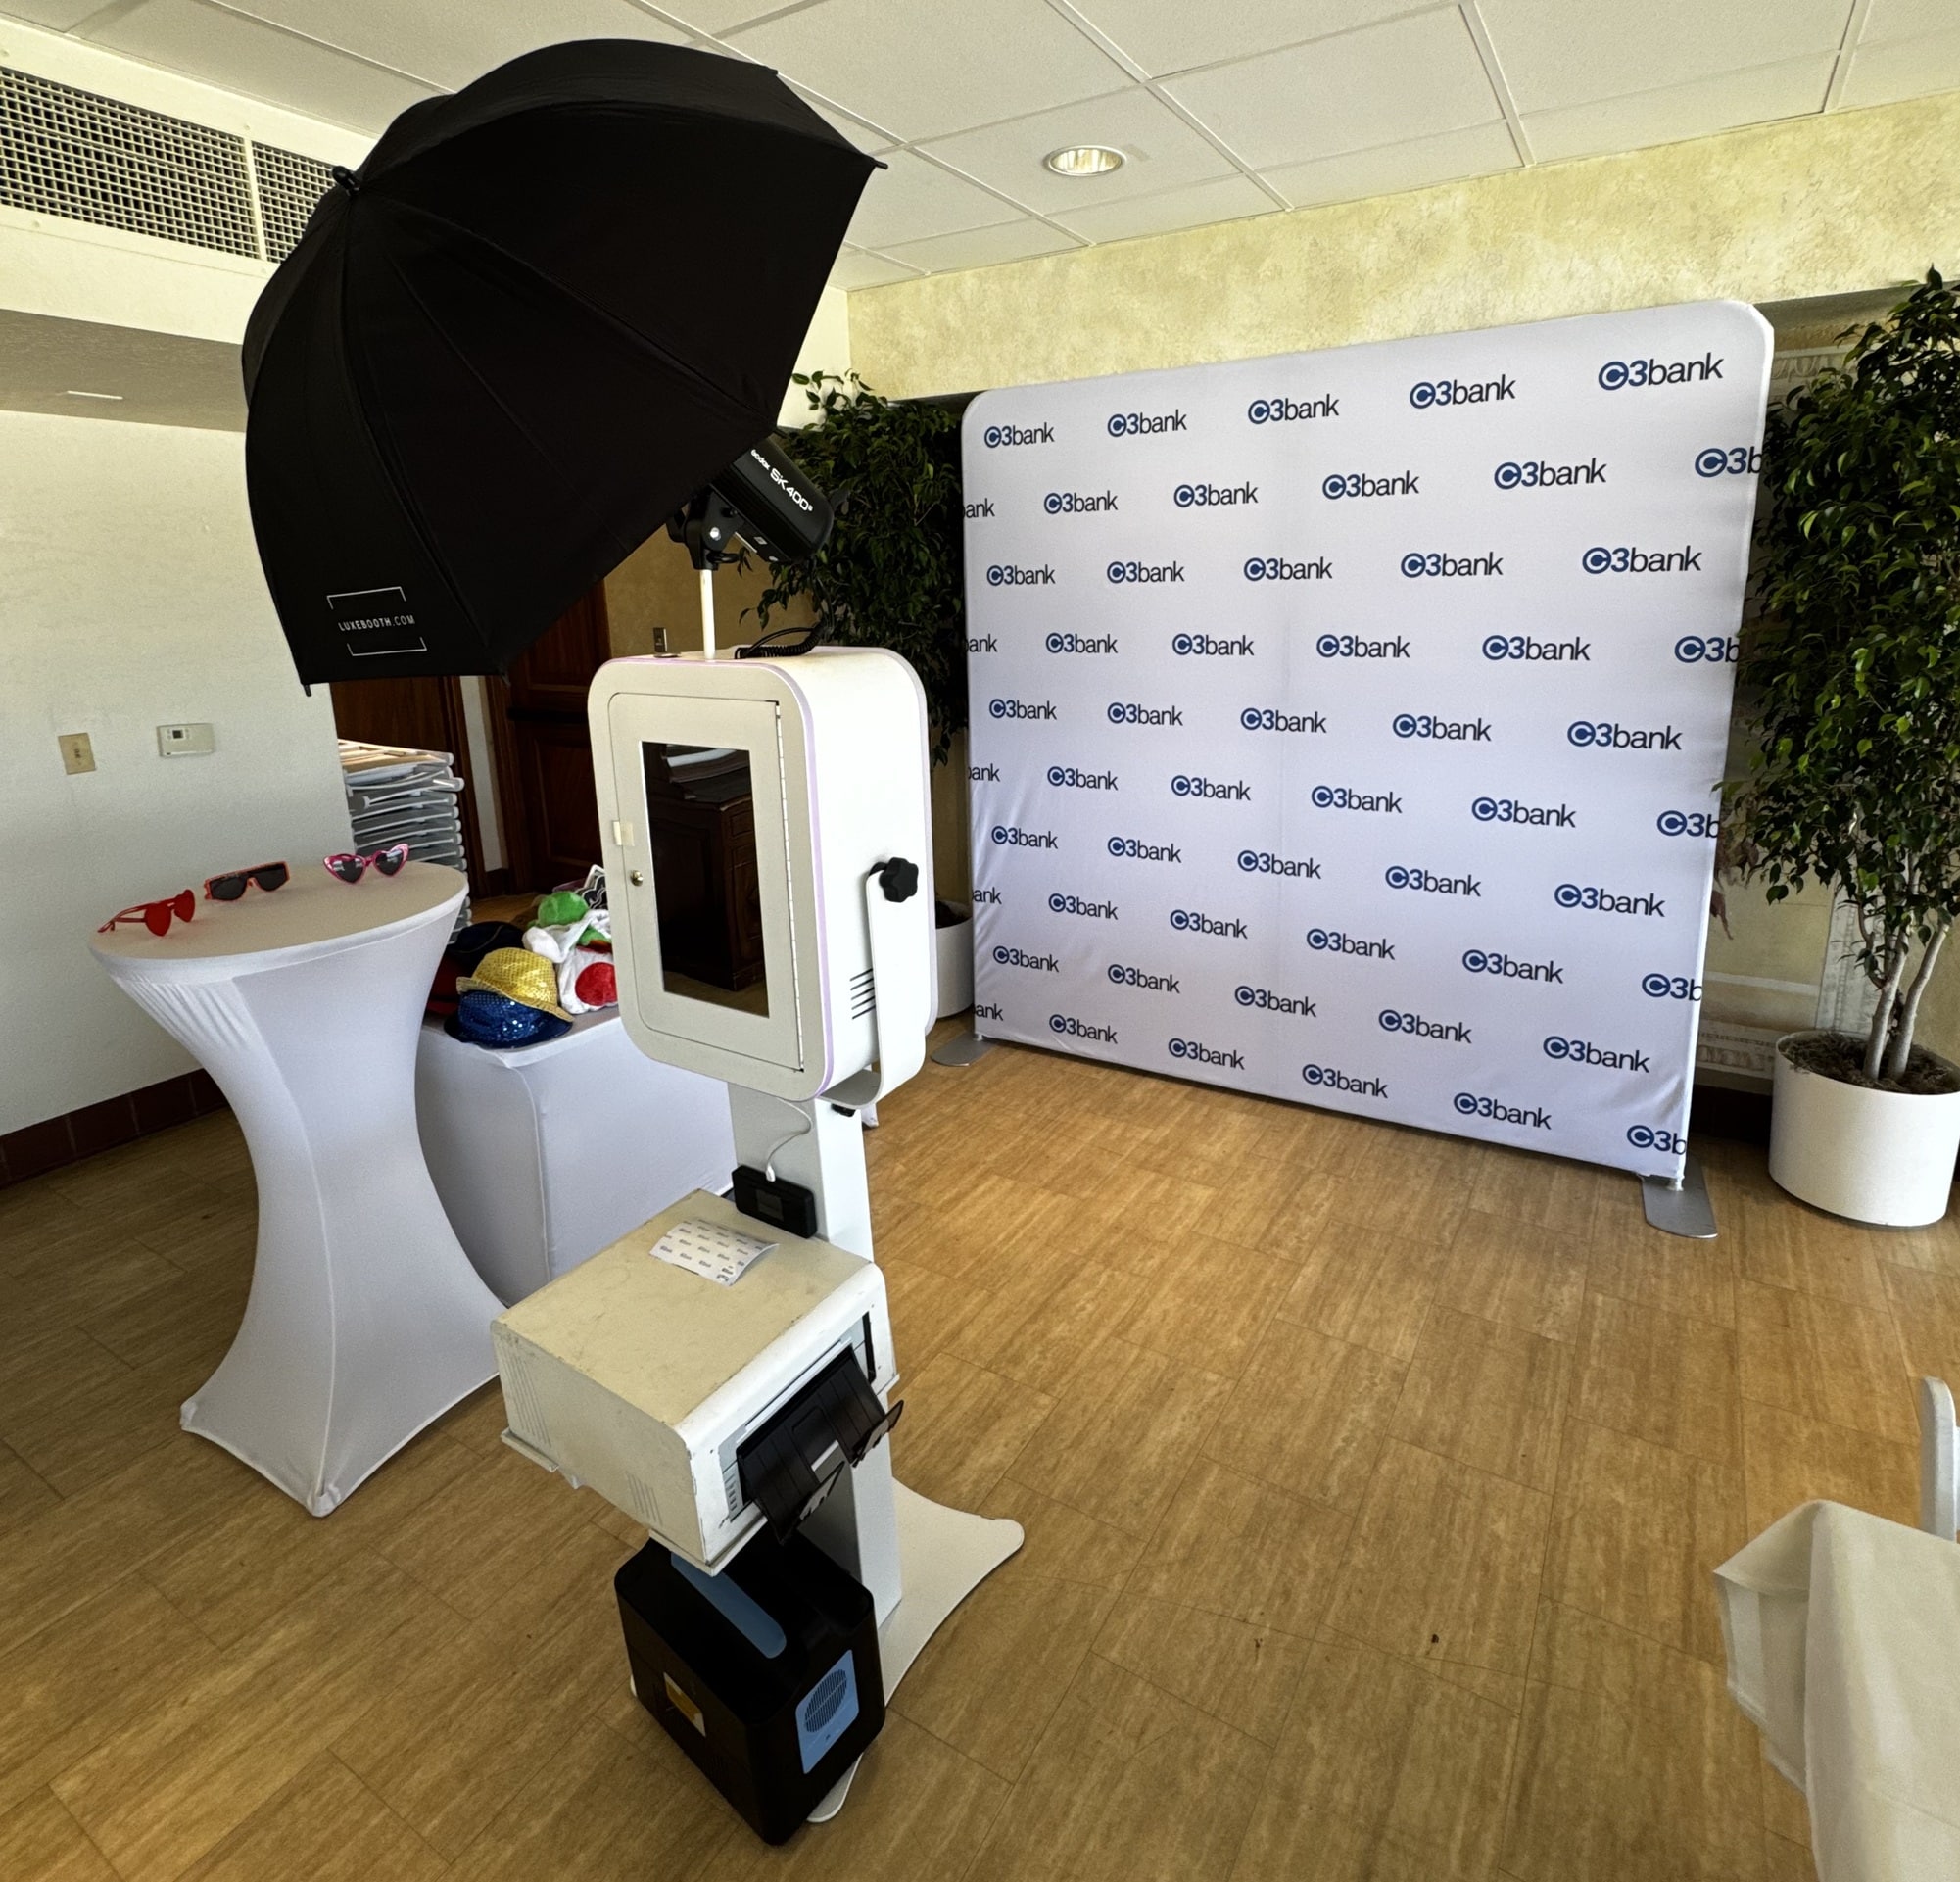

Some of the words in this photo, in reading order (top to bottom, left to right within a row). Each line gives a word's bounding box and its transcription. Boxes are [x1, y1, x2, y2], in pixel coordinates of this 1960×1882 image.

[1599, 353, 1723, 390] C3bank
[1410, 374, 1515, 409] C3bank
[1248, 394, 1338, 424] C3bank
[984, 422, 1054, 448] C3bank
[1108, 410, 1186, 437] C3bank
[1323, 470, 1418, 499] C3bank
[1495, 458, 1606, 489] C3bank
[963, 498, 995, 518] ank
[1044, 491, 1118, 514] C3bank
[1174, 482, 1258, 507] C3bank
[1107, 561, 1184, 583] C3bank
[1244, 557, 1332, 581] C3bank
[1401, 552, 1503, 578] C3bank
[1583, 546, 1701, 574] C3bank
[987, 564, 1055, 586] C3bank
[338, 614, 415, 632] LUXEBOOTH.COM
[967, 634, 998, 652] ank
[1046, 633, 1118, 653] C3bank
[1172, 634, 1254, 655] C3bank
[1316, 635, 1410, 657] C3bank
[1483, 635, 1590, 660] C3bank
[989, 699, 1057, 719] C3bank
[1108, 702, 1182, 725] C3bank
[1241, 708, 1326, 733] C3bank
[1393, 714, 1491, 741] C3bank
[1568, 721, 1682, 749] C3bank
[1047, 766, 1118, 790] C3bank
[1171, 776, 1250, 800] C3bank
[1312, 786, 1401, 813] C3bank
[1472, 797, 1575, 827] C3bank
[991, 826, 1058, 848] C3bank
[1108, 837, 1181, 862] C3bank
[1238, 850, 1320, 879] C3bank
[1386, 866, 1480, 896] C3bank
[973, 887, 1002, 904] ank
[1049, 893, 1118, 920] C3bank
[1554, 884, 1664, 917] C3bank
[1171, 910, 1247, 939] C3bank
[1307, 929, 1395, 959] C3bank
[992, 945, 1059, 972] C3bank
[1462, 950, 1563, 984] C3bank
[1108, 964, 1179, 993] C3bank
[974, 1003, 1004, 1021] ank
[1235, 986, 1316, 1017] C3bank
[1049, 1014, 1118, 1044] C3bank
[1379, 1010, 1471, 1043] C3bank
[1169, 1038, 1244, 1070] C3bank
[1543, 1037, 1649, 1073] C3bank
[1303, 1064, 1388, 1098] C3bank
[1454, 1093, 1551, 1130] C3bank
